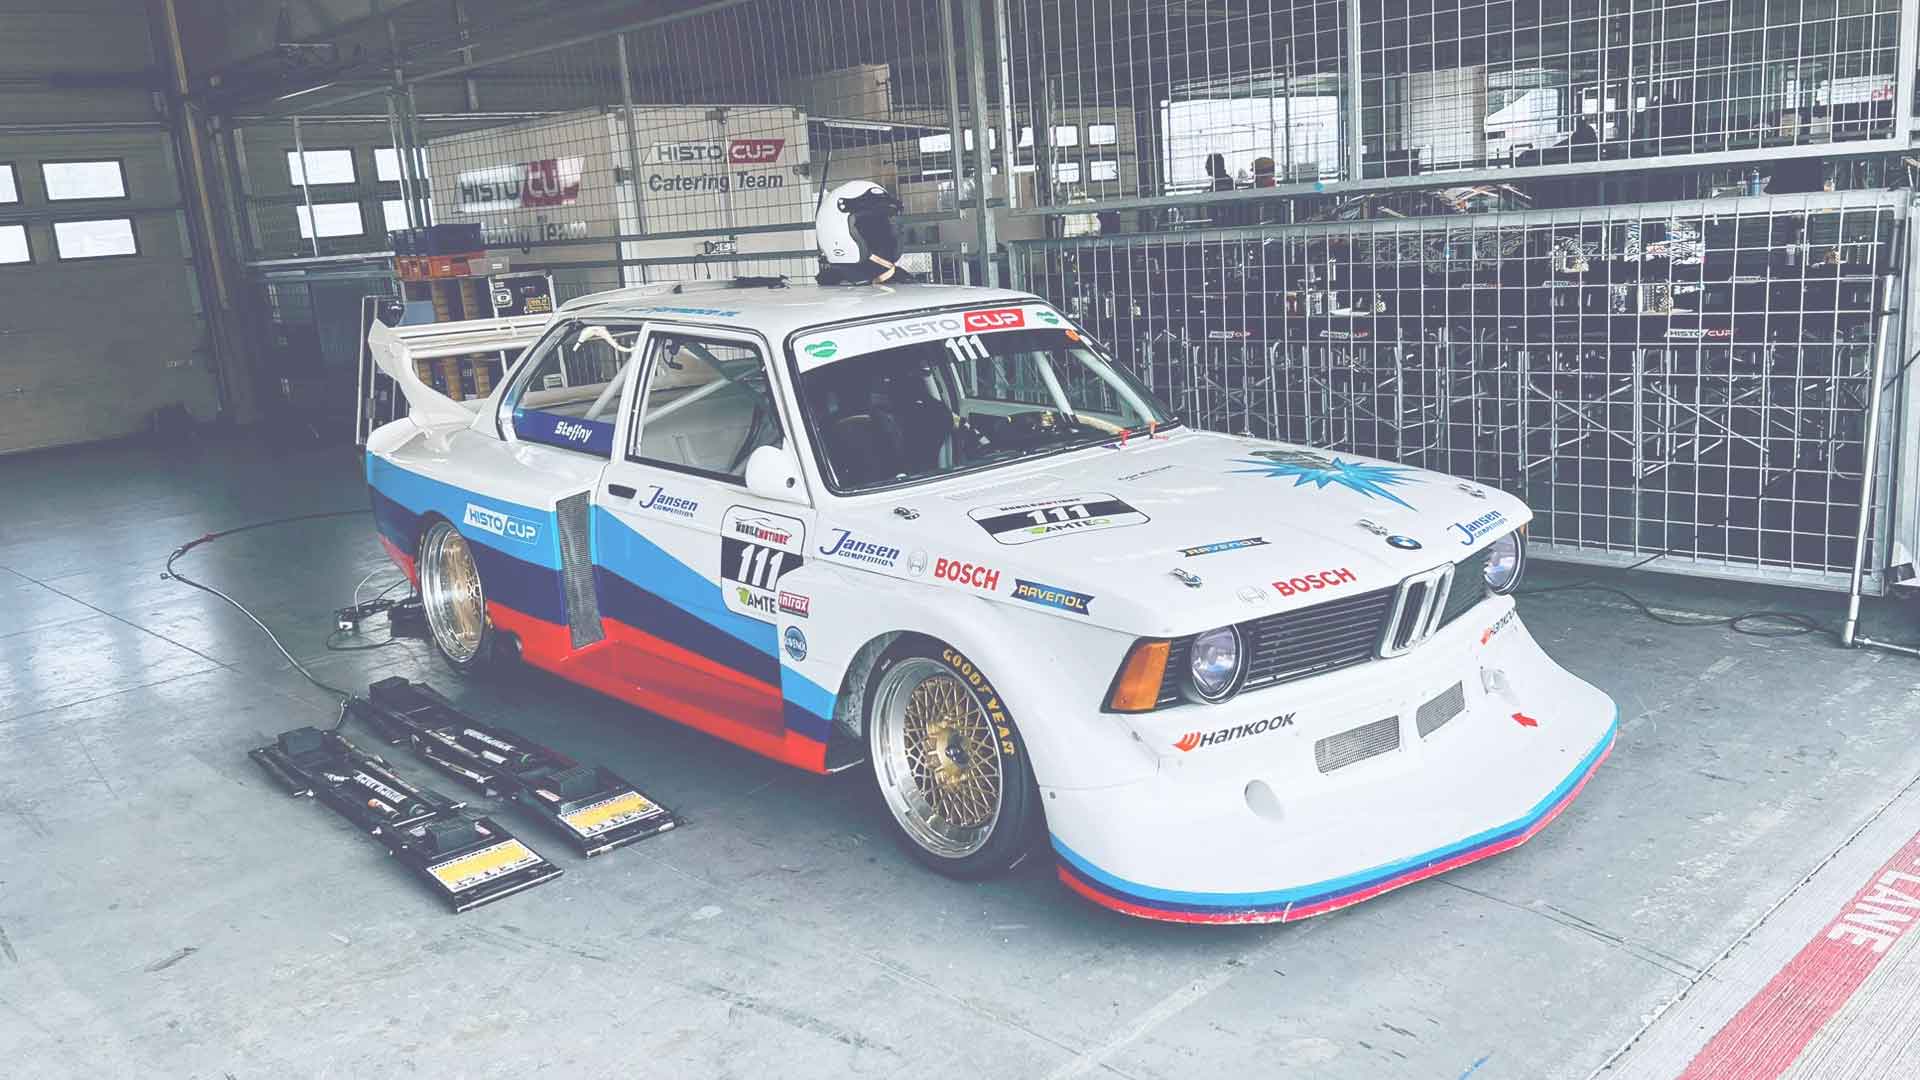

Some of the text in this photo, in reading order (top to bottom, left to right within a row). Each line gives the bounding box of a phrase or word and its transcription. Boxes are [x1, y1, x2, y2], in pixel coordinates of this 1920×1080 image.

[657, 143, 777, 161] HISTO CUP
[649, 171, 783, 193] Catering Team
[877, 312, 1019, 341] HISTO CUP
[945, 334, 990, 362] 111
[555, 420, 593, 444] Steffny
[640, 485, 699, 512] Jansen
[468, 507, 536, 539] HISTO CUP
[1026, 504, 1090, 524] 111
[1447, 510, 1502, 546] Jansen
[819, 528, 900, 560] Jansen
[737, 544, 784, 591] 111
[838, 549, 894, 568] COMPETITION
[934, 557, 1001, 592] BOSCH
[1272, 567, 1357, 597] BOSCH
[1017, 584, 1085, 610] RAVENOL
